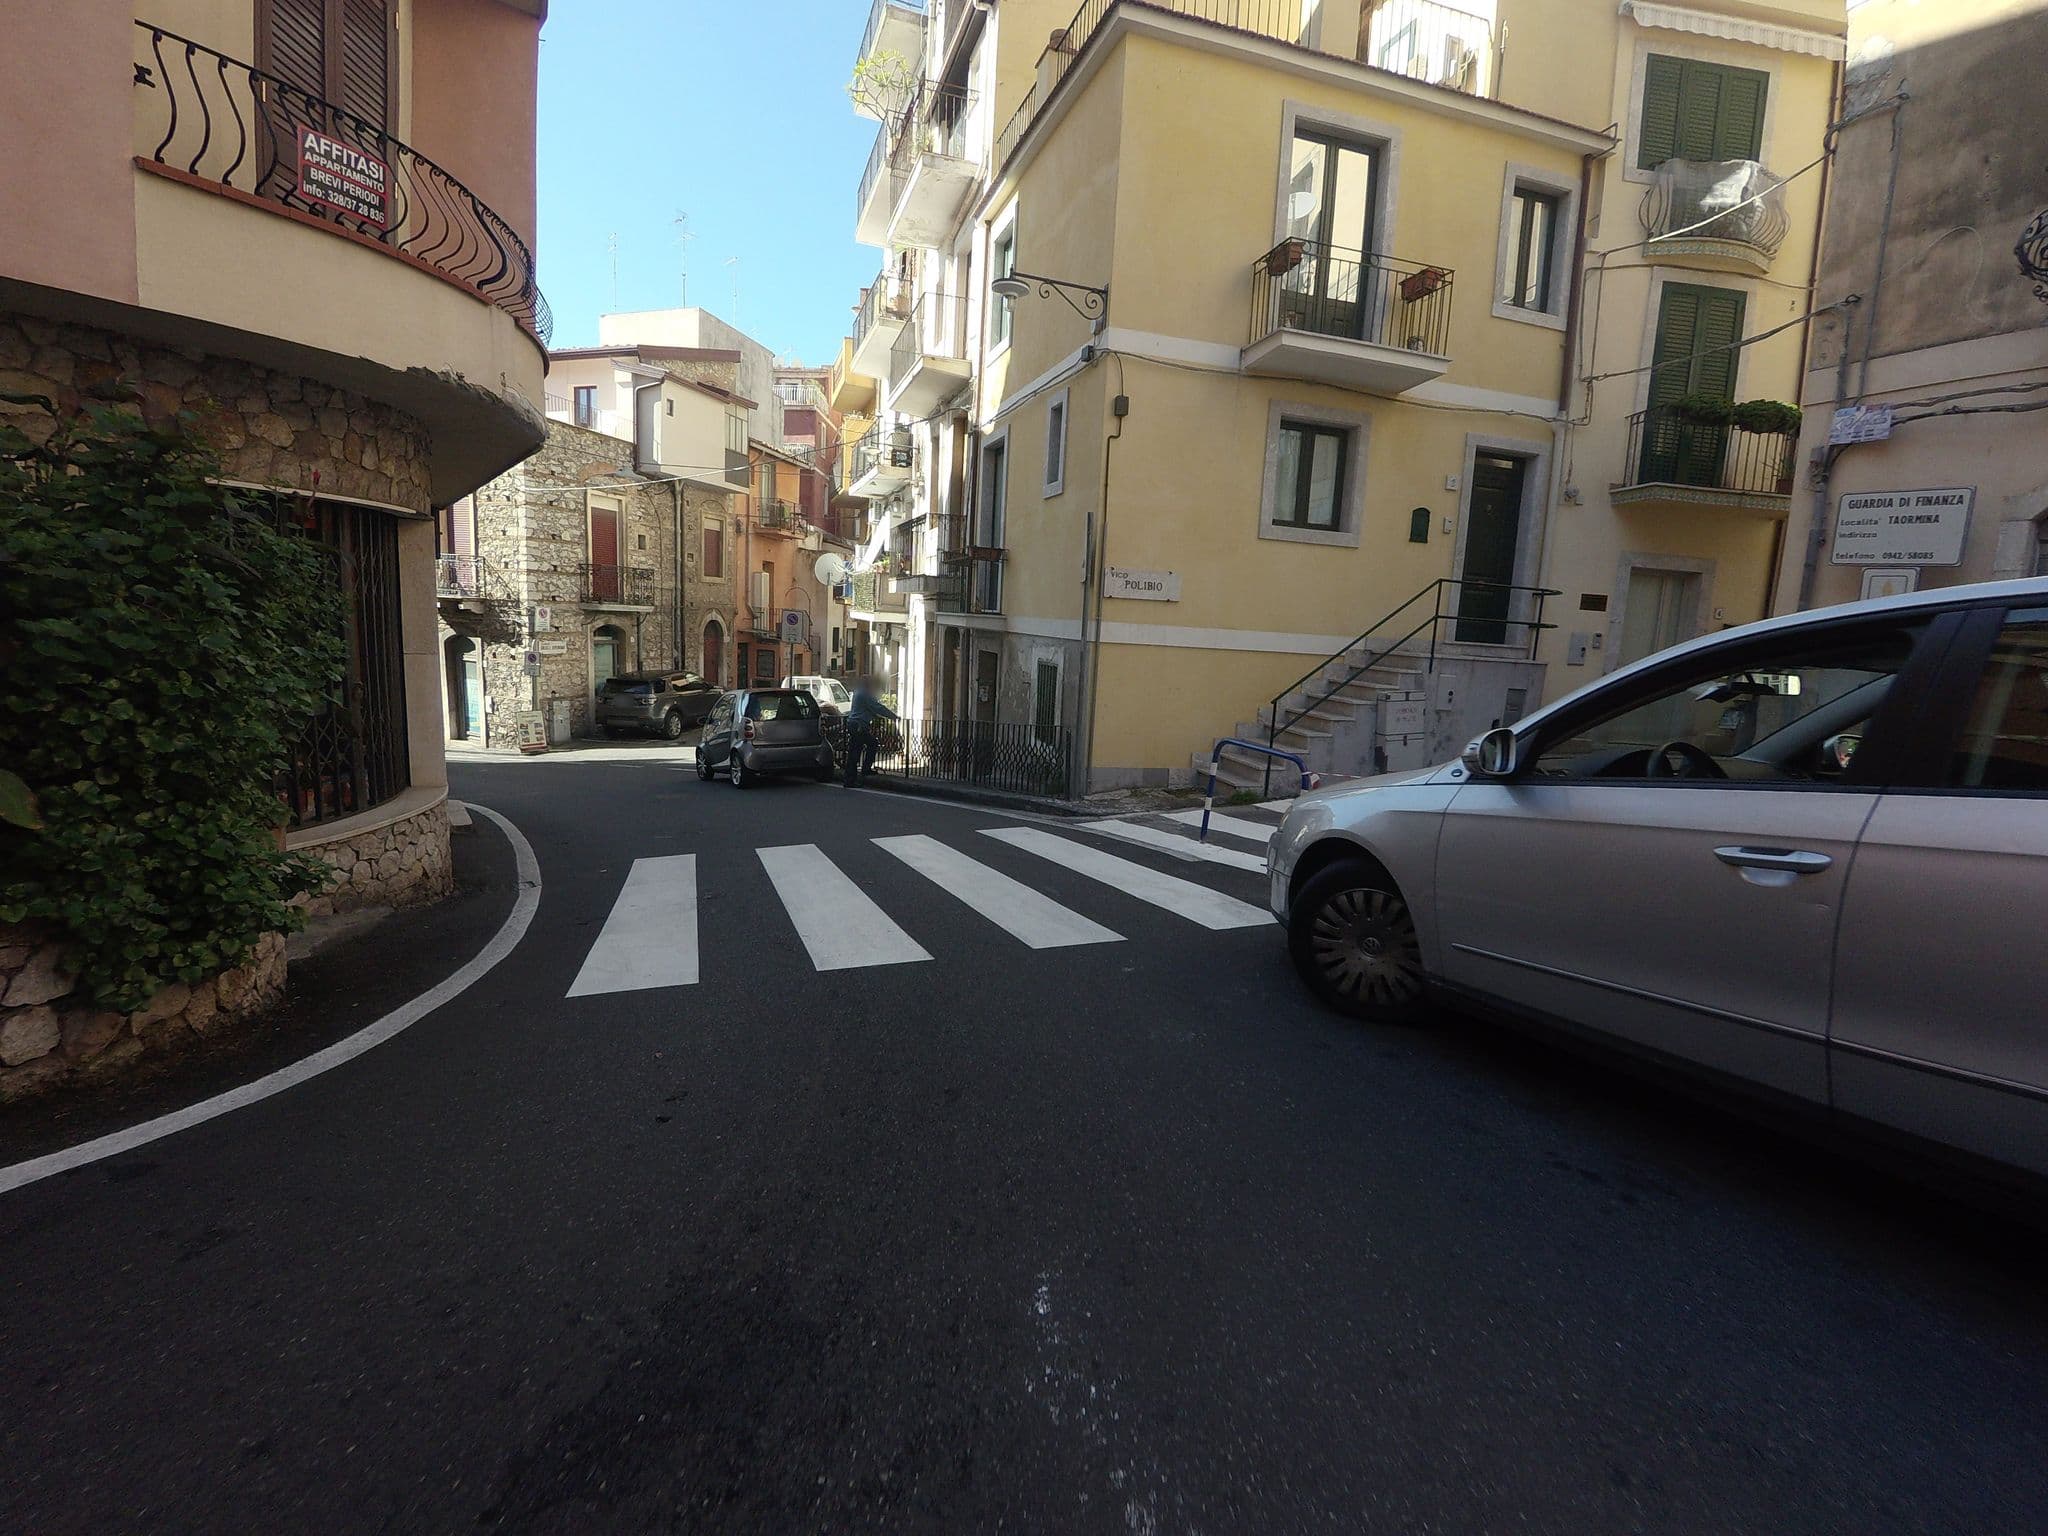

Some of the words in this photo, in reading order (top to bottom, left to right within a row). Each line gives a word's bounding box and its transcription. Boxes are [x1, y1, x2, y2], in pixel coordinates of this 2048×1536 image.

[304, 133, 383, 182] AFFITASI
[304, 152, 385, 193] APPARTAMENTO
[310, 167, 341, 190] BREVI
[343, 181, 379, 206] PERIODI
[1848, 498, 1894, 509] GUARDIA
[1899, 497, 1910, 507] DI
[1915, 494, 1964, 507] FINANZA
[1888, 514, 1940, 525] TAORMINA
[1835, 552, 1876, 560] telefono
[1111, 571, 1129, 579] VICO
[1124, 580, 1163, 591] POLIBIO
